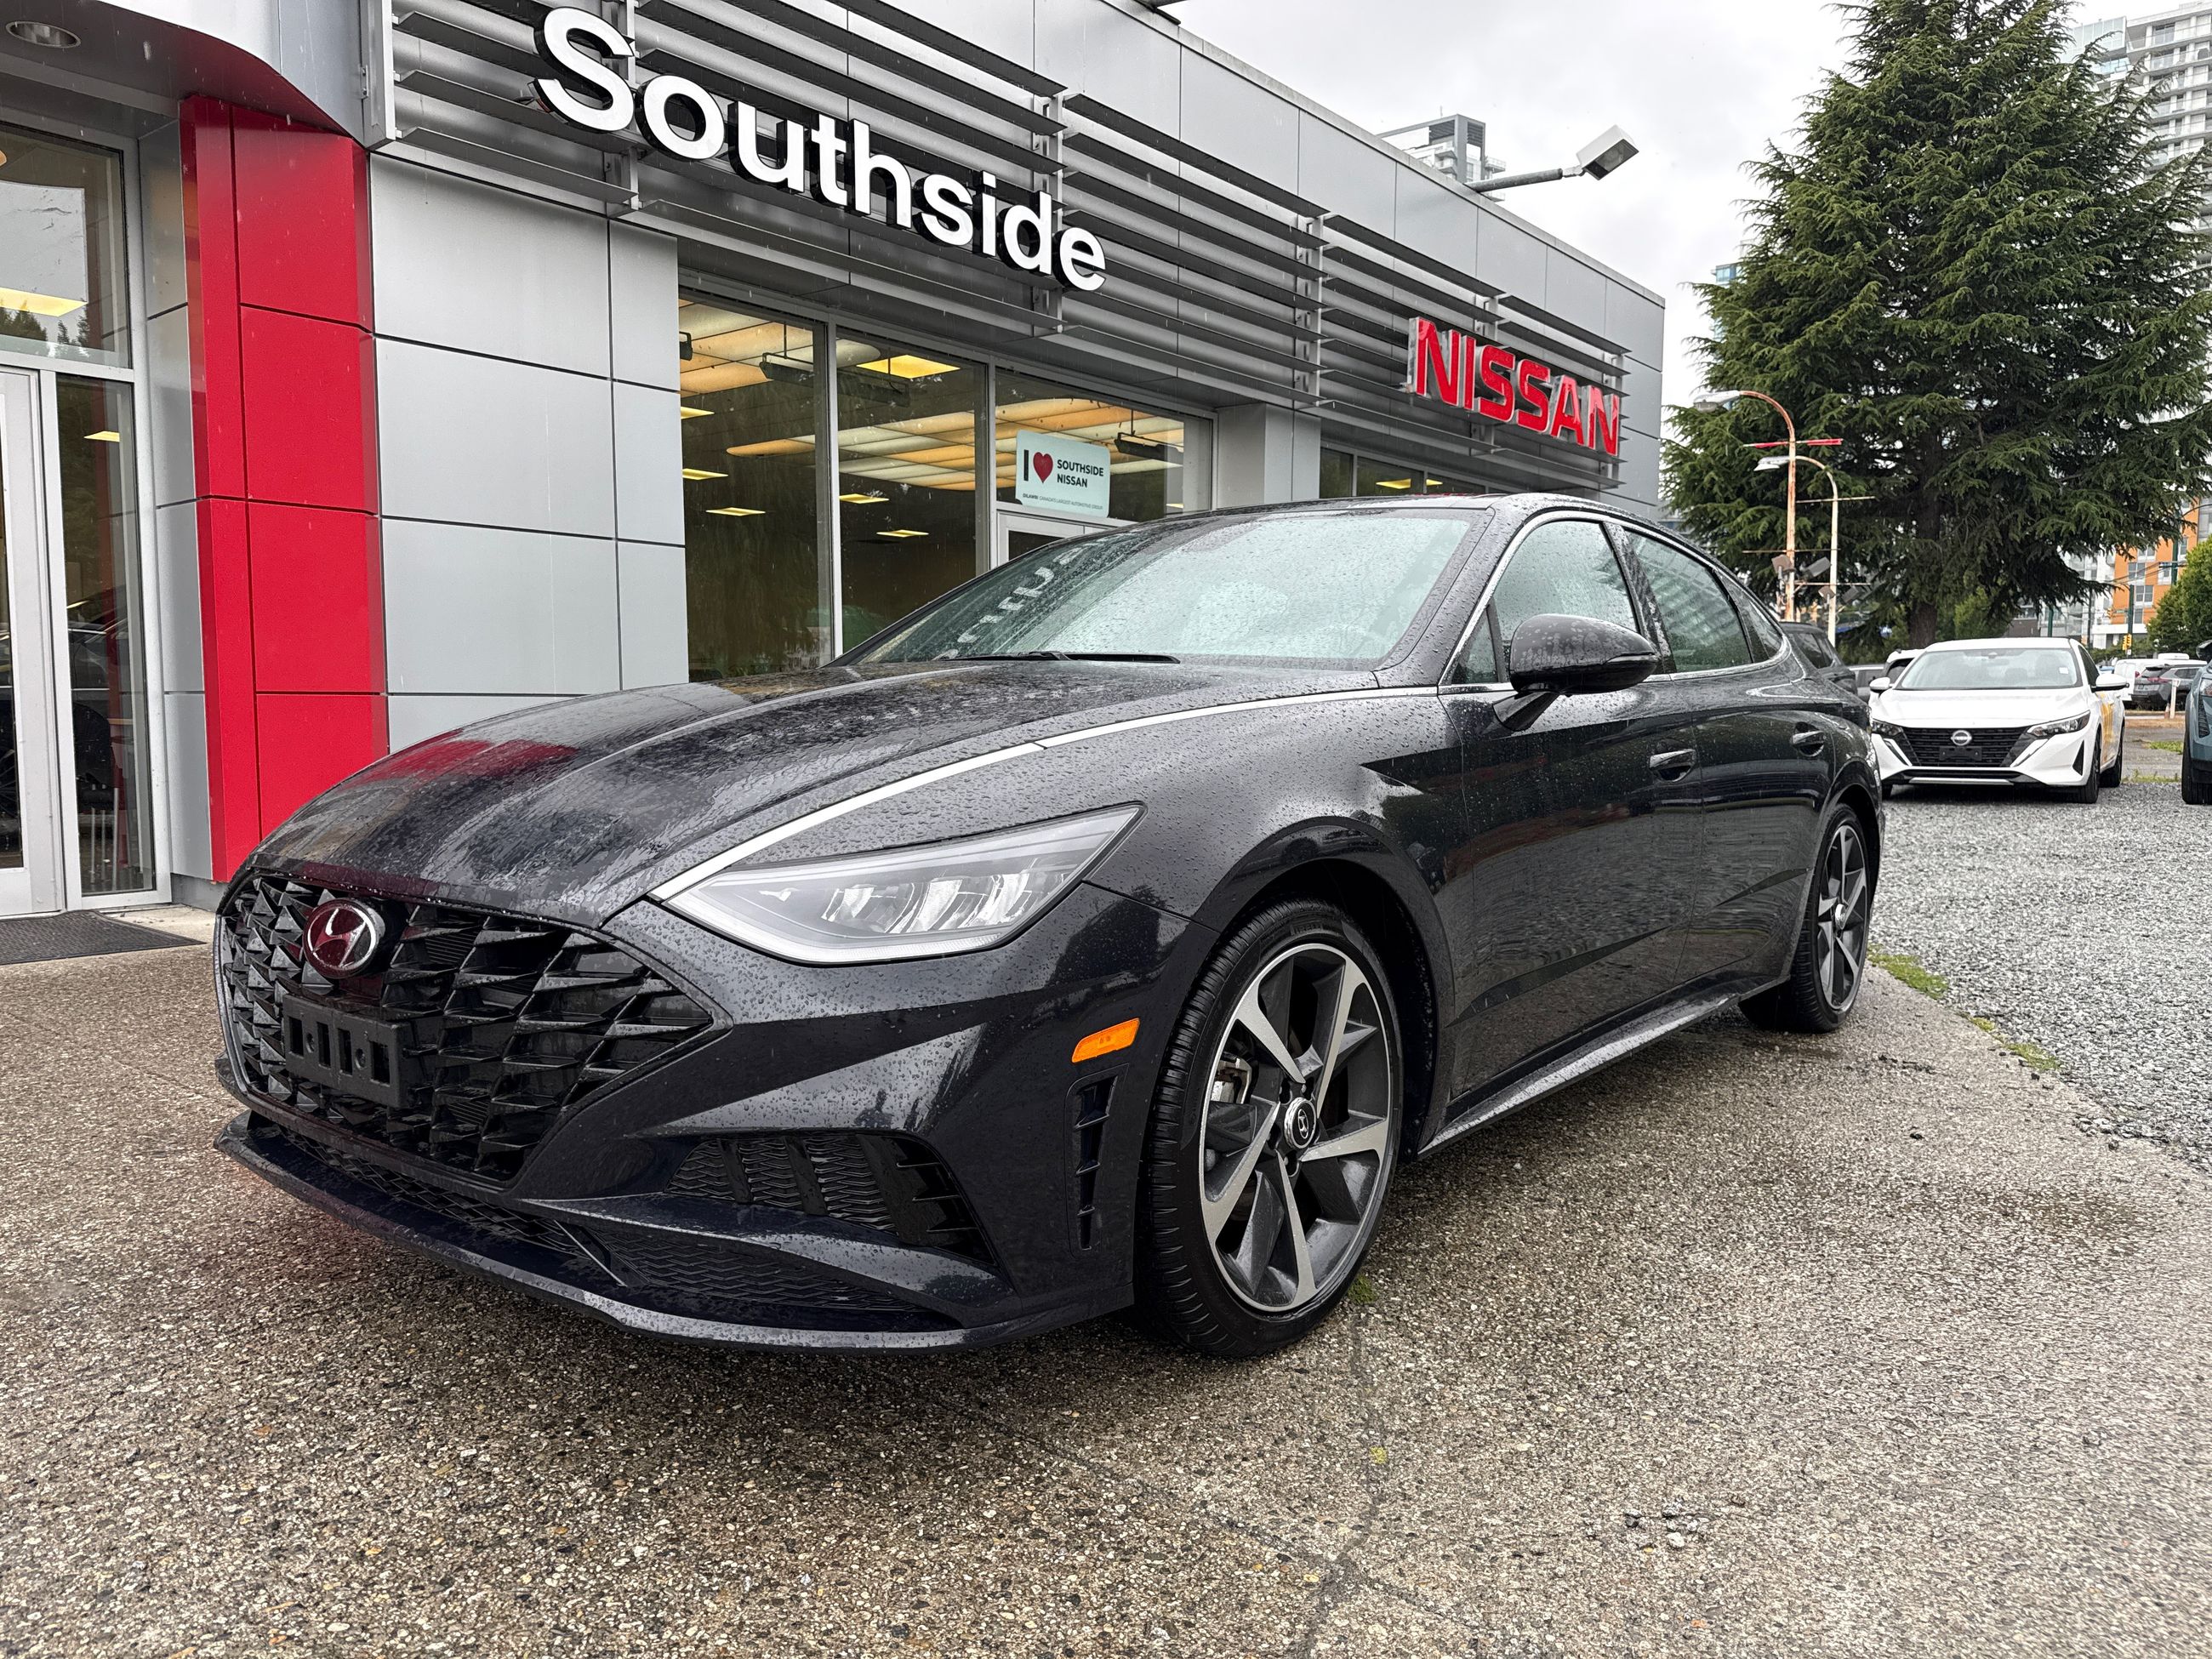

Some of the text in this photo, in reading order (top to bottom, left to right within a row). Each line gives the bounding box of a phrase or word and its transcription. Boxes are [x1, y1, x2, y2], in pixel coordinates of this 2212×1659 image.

[534, 6, 1106, 292] Southside
[1413, 316, 1620, 457] NISSAN
[1023, 449, 1029, 482] I
[1057, 459, 1104, 477] SOUTHSIDE
[1057, 474, 1088, 488] NISSAN
